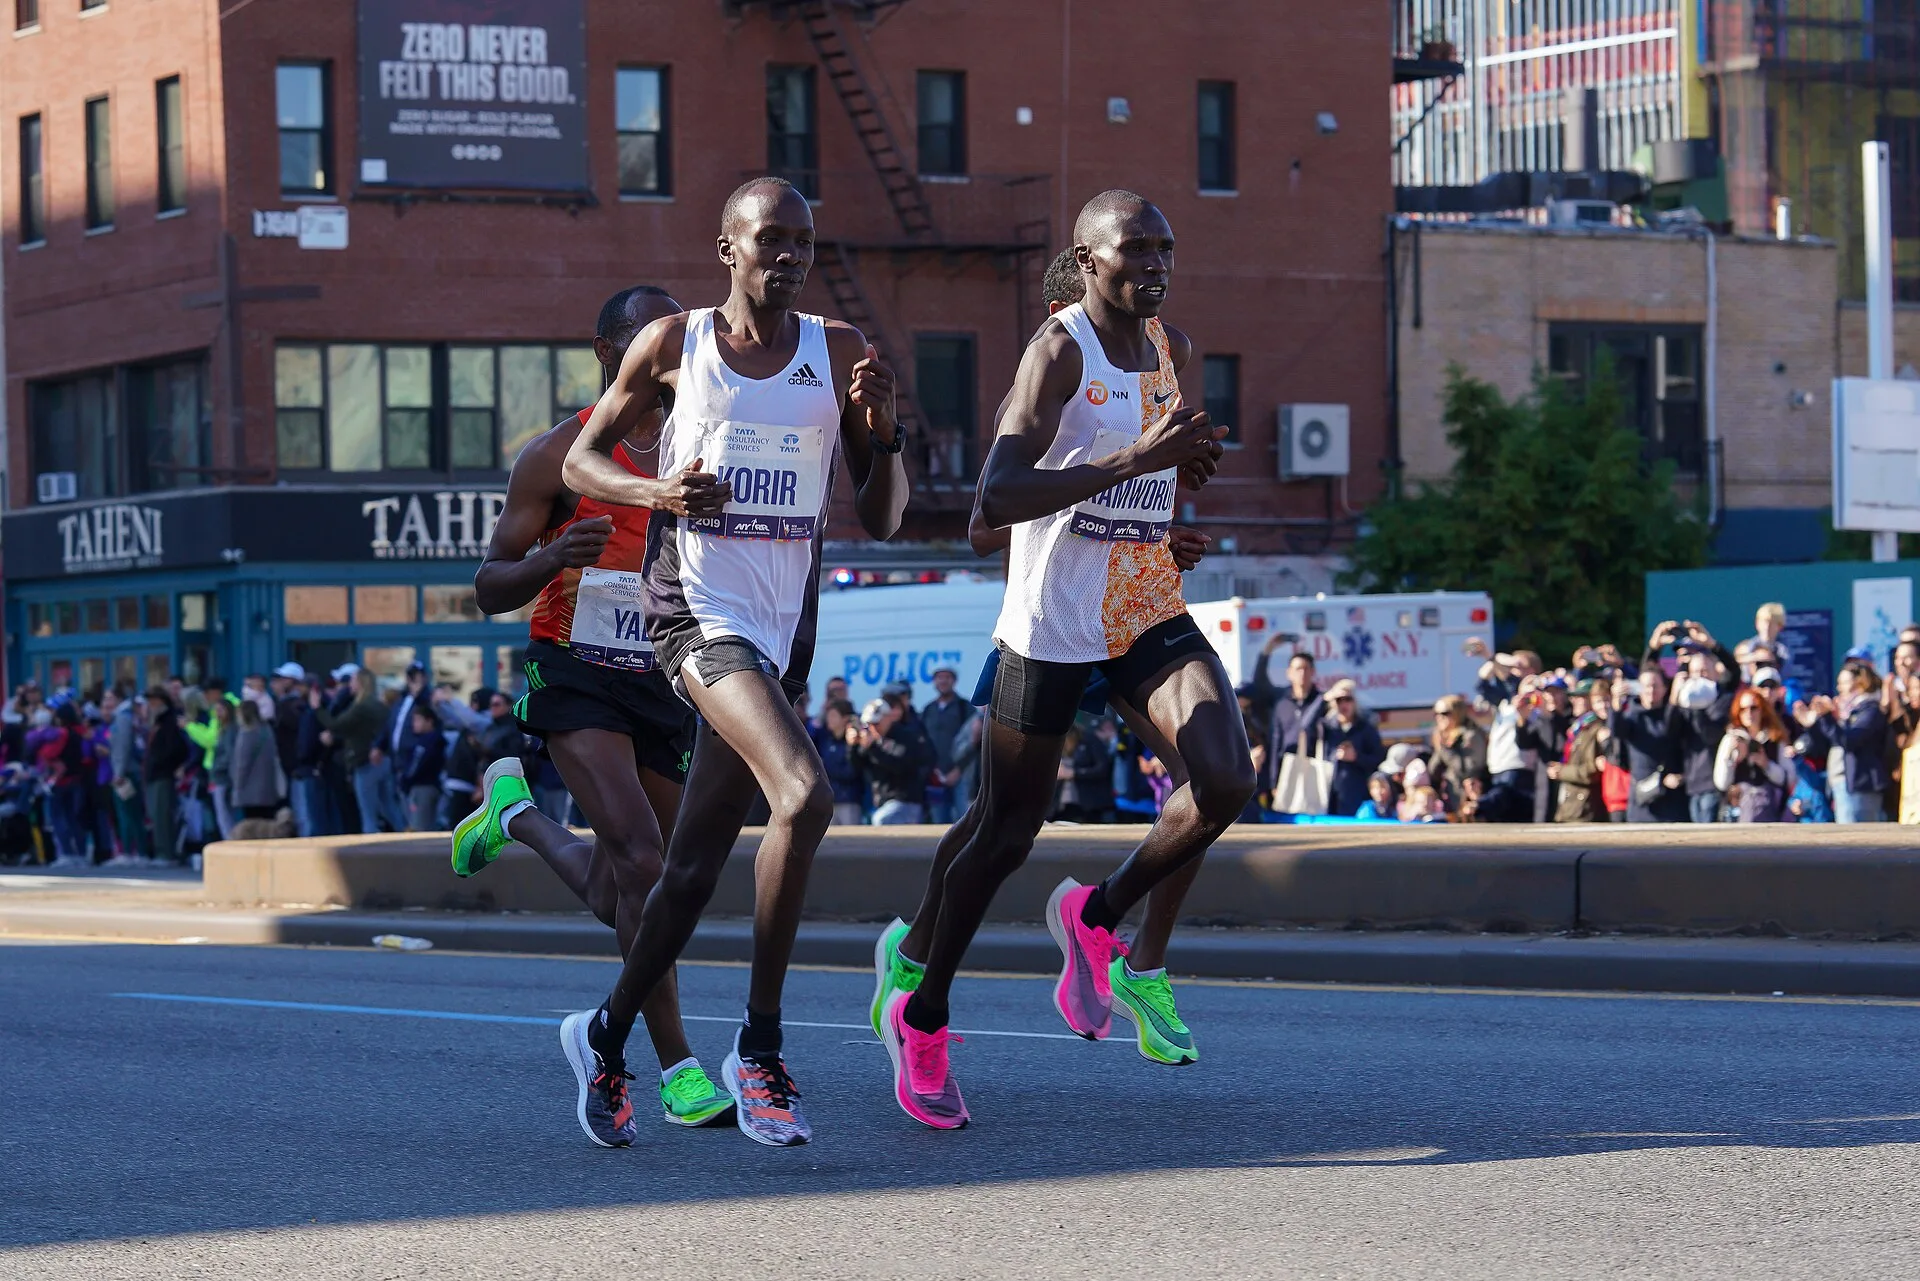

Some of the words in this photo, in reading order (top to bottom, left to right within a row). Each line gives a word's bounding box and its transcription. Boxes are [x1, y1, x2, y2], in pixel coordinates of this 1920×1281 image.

[401, 23, 465, 62] ZERO
[468, 25, 549, 64] NEVER
[379, 60, 433, 99] FELT
[436, 63, 496, 101] THIS
[501, 65, 576, 104] GOOD.
[788, 376, 823, 387] adidas
[1112, 390, 1129, 400] NN
[720, 435, 770, 445] CONSULTANCY
[735, 428, 756, 436] TATA
[728, 444, 760, 453] SERVICES
[717, 465, 798, 506] KORIR
[1090, 477, 1175, 511] AMWORO
[695, 517, 721, 529] 2019
[1078, 519, 1107, 535] 2019
[57, 505, 164, 563] TAHENI
[618, 576, 637, 584] TATA
[611, 588, 640, 598] SERVICES
[1291, 633, 1339, 661] FD.
[843, 650, 963, 686] POLIC
[1314, 671, 1407, 691] AMLANCE
